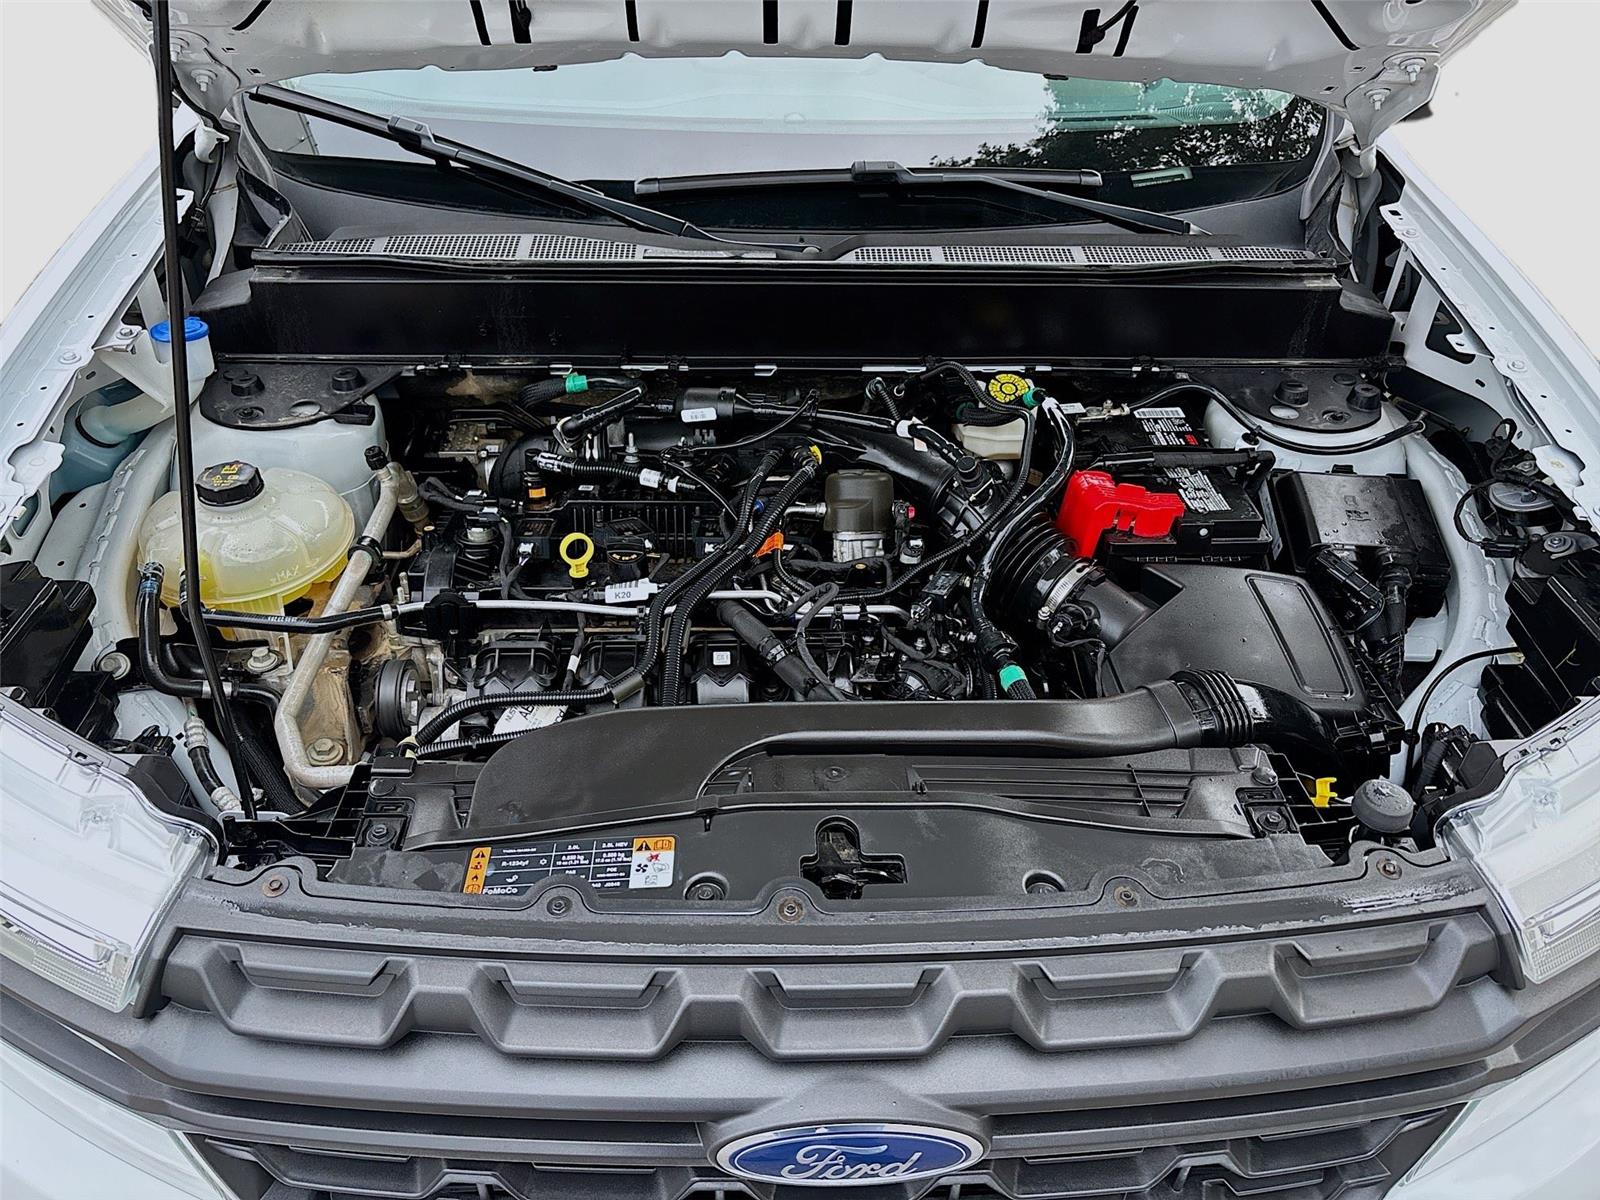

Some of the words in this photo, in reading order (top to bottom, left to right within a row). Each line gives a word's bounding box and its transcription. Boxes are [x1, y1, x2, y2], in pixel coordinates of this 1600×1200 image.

[276, 565, 299, 582] MAX
[614, 591, 632, 600] K20
[501, 859, 529, 867] R-1234yf
[482, 887, 518, 895] FoMoCo
[781, 1144, 922, 1179] Ford
